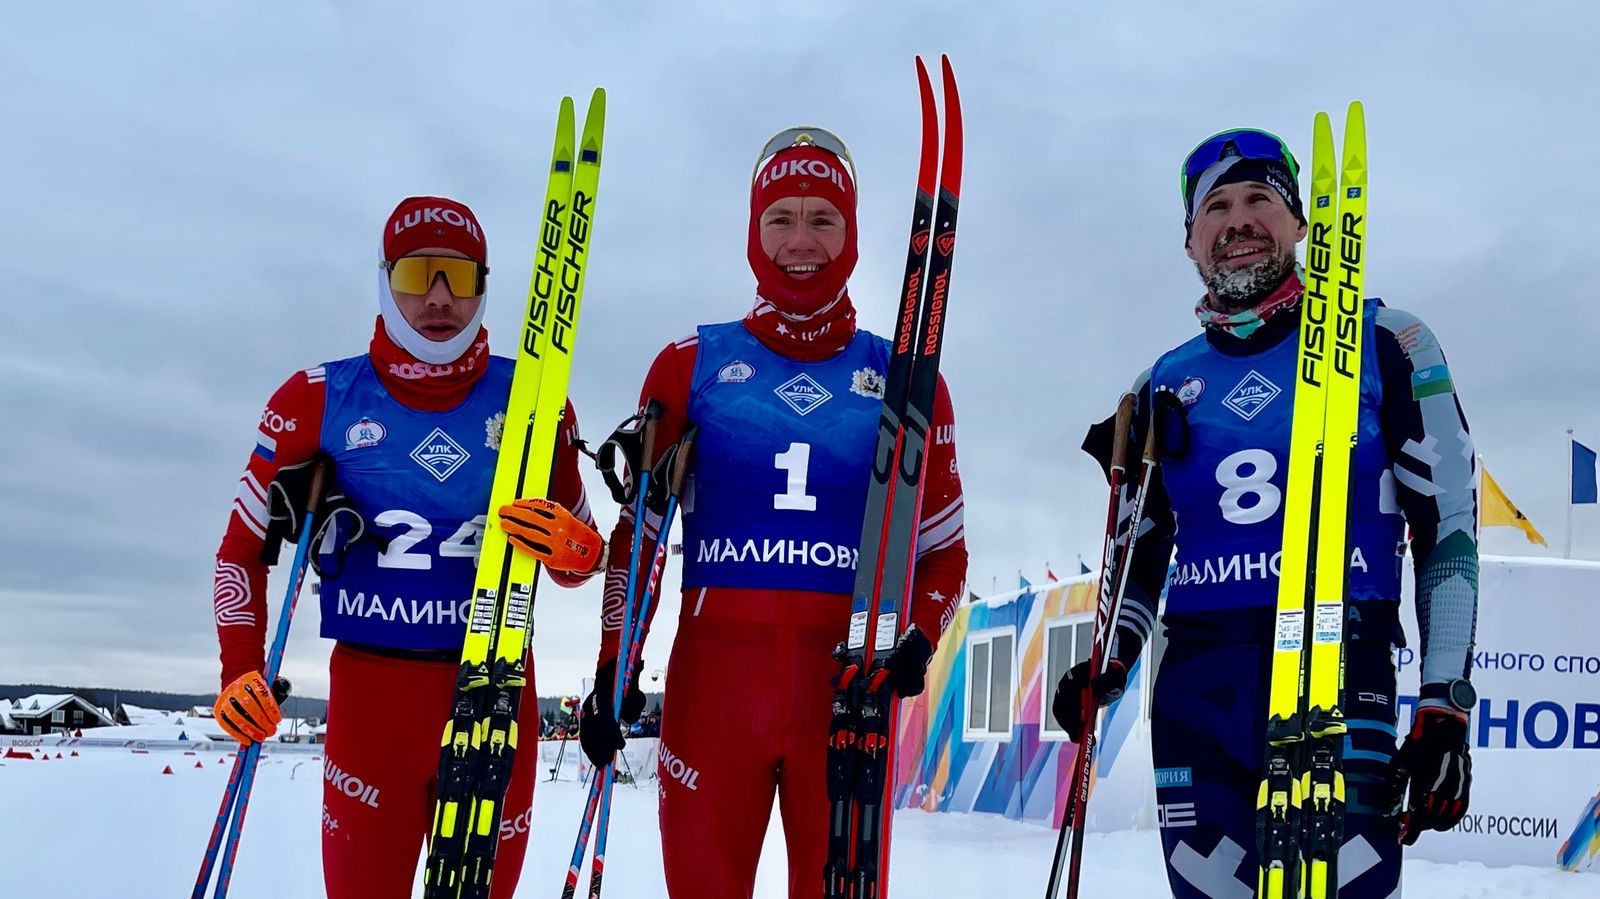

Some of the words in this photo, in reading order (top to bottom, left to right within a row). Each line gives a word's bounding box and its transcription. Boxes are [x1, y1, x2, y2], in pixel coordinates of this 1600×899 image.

[762, 159, 845, 192] LUKOIL
[1266, 175, 1293, 206] UGRA
[394, 207, 480, 242] LUKOIL
[524, 199, 566, 360] FISCHER
[552, 190, 592, 354] FISCHER
[1334, 211, 1362, 379] FISCHER
[898, 267, 920, 354] ROSSIGNOL
[924, 268, 948, 355] ROSSIGNOL
[1302, 222, 1332, 388] FISCHER
[792, 384, 815, 394] УЛК
[1240, 385, 1263, 397] УЛК
[428, 444, 452, 454] УЛК
[773, 442, 817, 511] 1
[1215, 448, 1282, 525] 8
[373, 509, 488, 570] 24
[12, 739, 40, 747] BOSCO
[660, 741, 700, 791] UKOIL
[1487, 815, 1558, 839] РОССИИ
